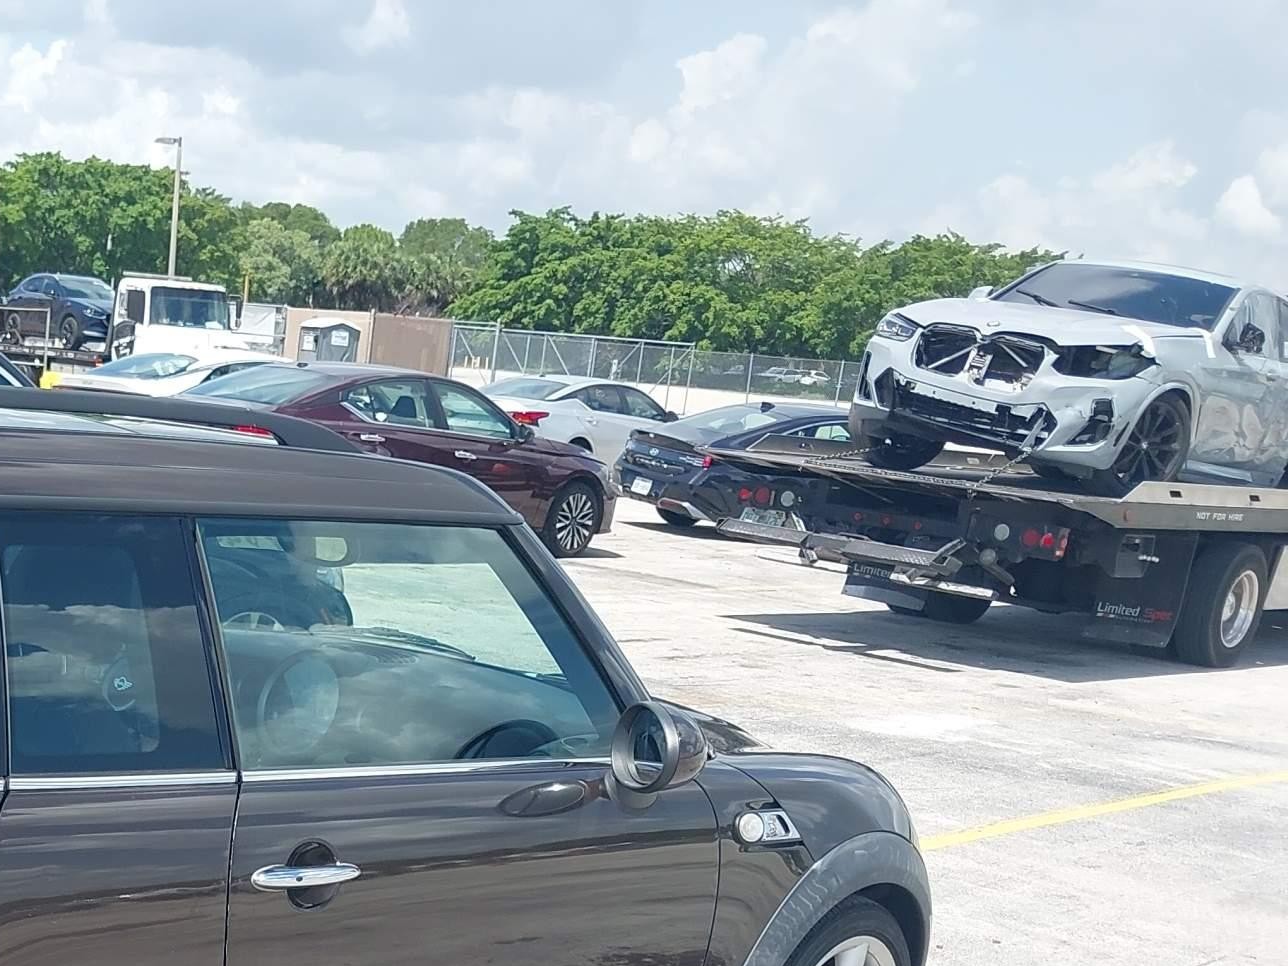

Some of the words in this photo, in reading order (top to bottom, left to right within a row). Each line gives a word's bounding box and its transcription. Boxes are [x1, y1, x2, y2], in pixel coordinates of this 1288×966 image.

[1196, 511, 1211, 520] NOT
[1212, 512, 1227, 521] FOR
[1097, 601, 1141, 617] Limited
